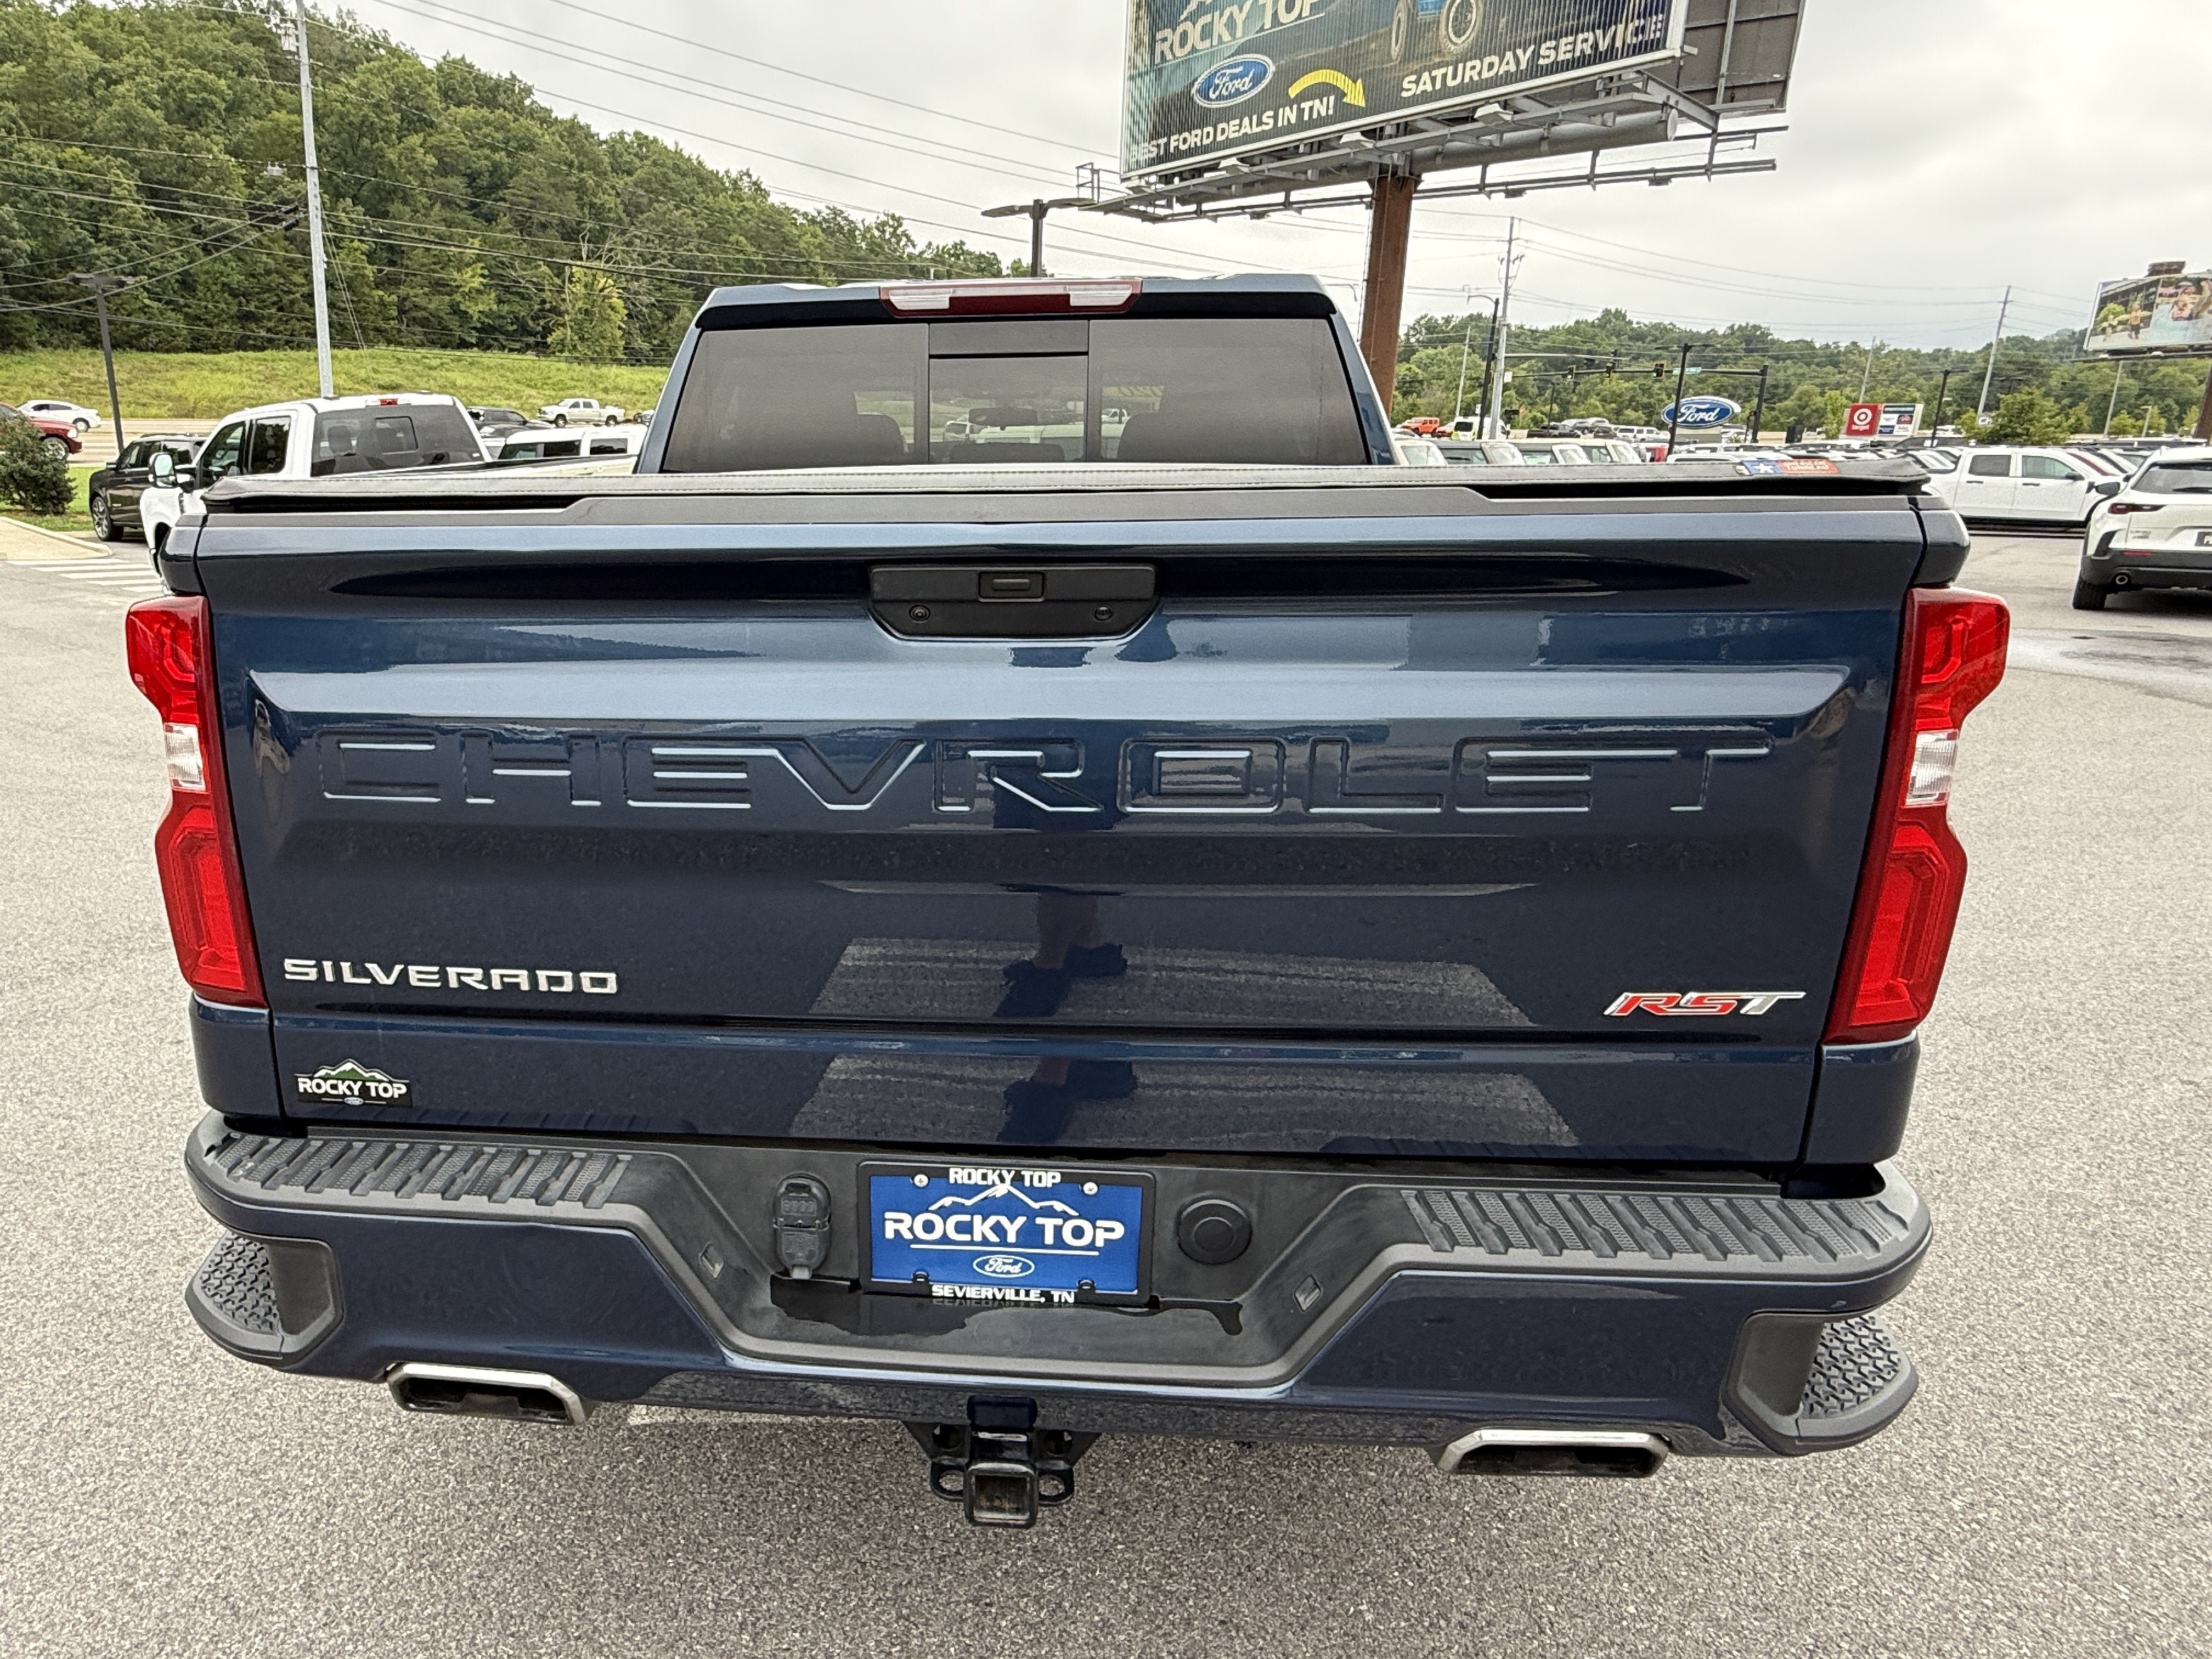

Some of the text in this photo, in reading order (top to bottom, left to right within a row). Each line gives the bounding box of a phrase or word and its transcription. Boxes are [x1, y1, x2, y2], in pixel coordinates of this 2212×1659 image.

[1155, 0, 1252, 64] ROCKY
[1401, 14, 1664, 97] SATURDAY SERVICE
[1209, 65, 1256, 99] Ford
[1170, 126, 1213, 153] FORD
[1217, 111, 1274, 142] DEALS
[1277, 105, 1297, 127] IN
[1300, 95, 1335, 121] TN!
[1677, 404, 1720, 422] Ford
[316, 729, 1774, 815] CHEVROLET
[284, 958, 618, 994] SILVERADO
[1604, 992, 1806, 1016] RST
[297, 1077, 408, 1098] ROCKY TOP
[949, 1167, 1062, 1188] ROCKY TOP
[884, 1212, 1125, 1248] ROCKY TOP
[984, 1258, 1022, 1273] Ford
[932, 1284, 1075, 1304] SEVIERVILLE, TN
